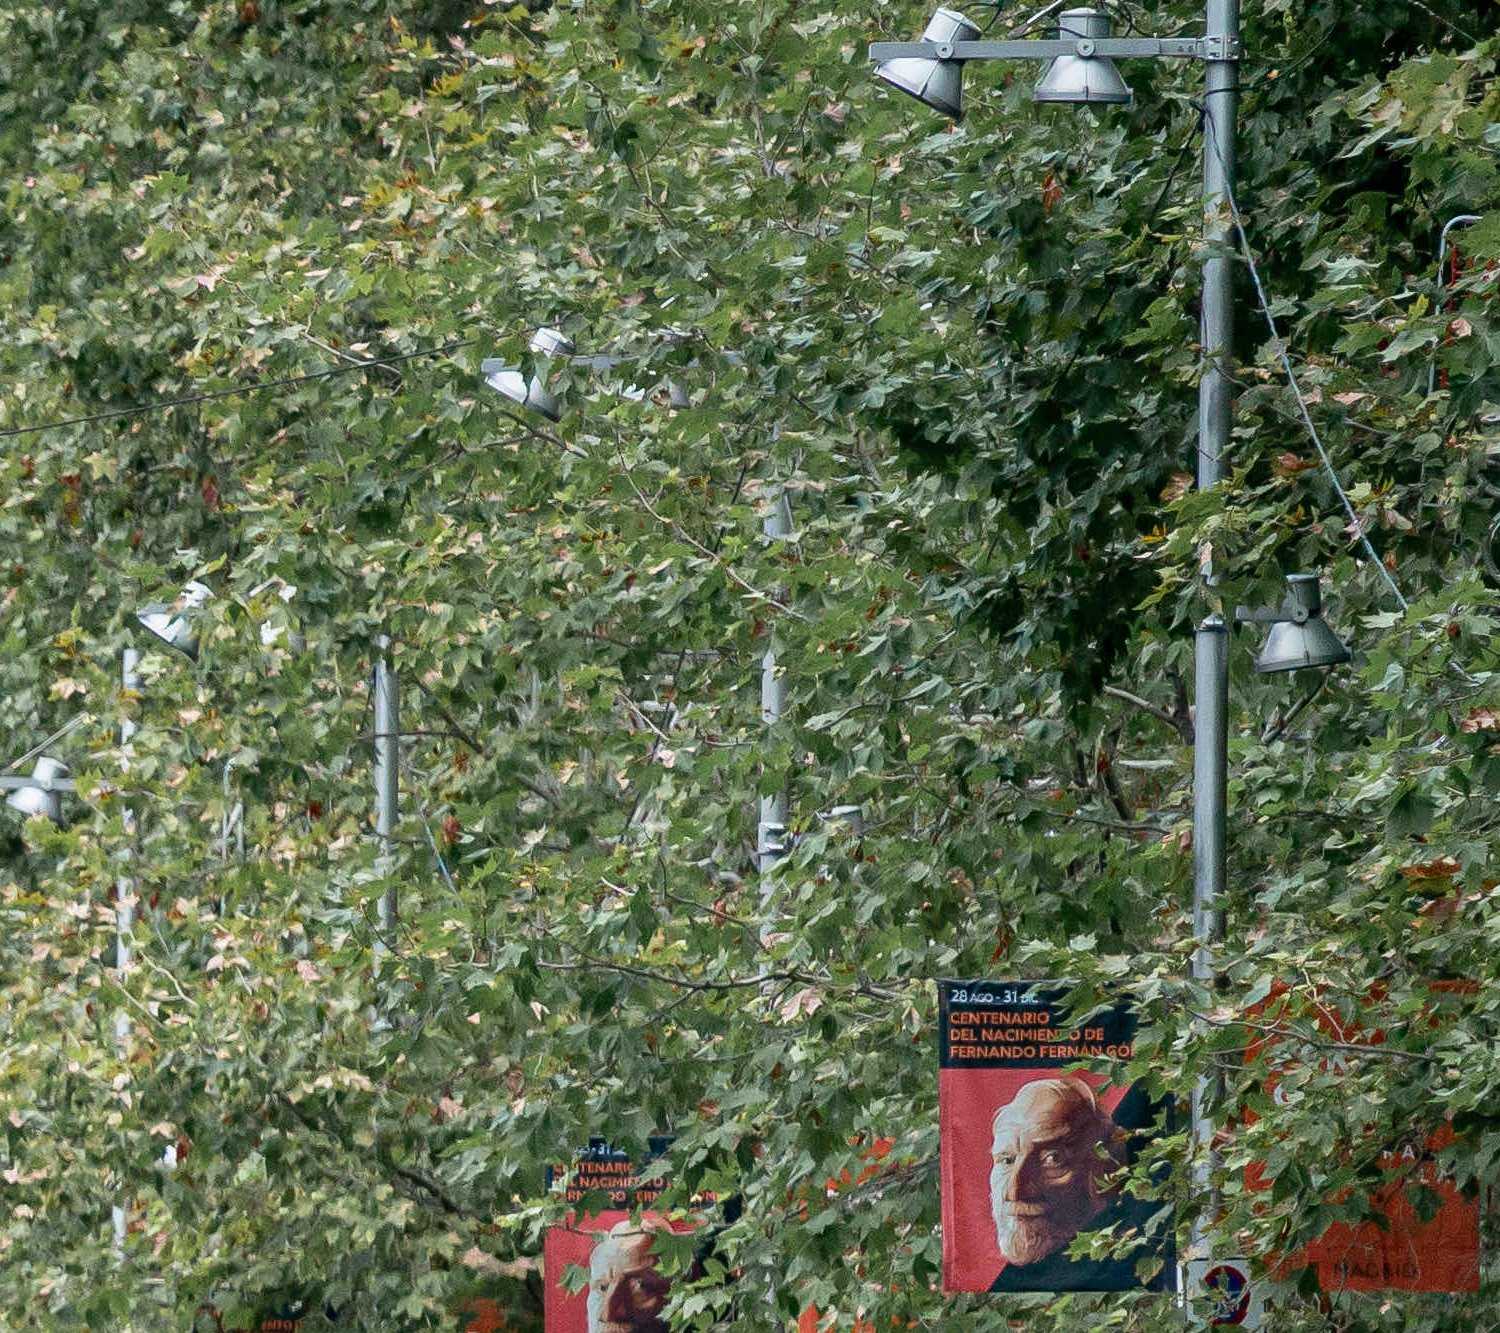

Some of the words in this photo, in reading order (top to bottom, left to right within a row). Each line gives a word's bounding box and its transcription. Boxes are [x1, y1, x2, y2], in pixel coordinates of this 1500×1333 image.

[951, 989, 968, 1003] 28
[971, 993, 994, 1003] AGO
[1004, 989, 1017, 1003] 31
[950, 1011, 1051, 1025] CENTENARIO
[950, 1028, 977, 1041] DEL
[982, 1028, 1081, 1042] NACIMIENO
[1084, 1028, 1105, 1041] DE
[950, 1045, 1036, 1059] FERNANDO
